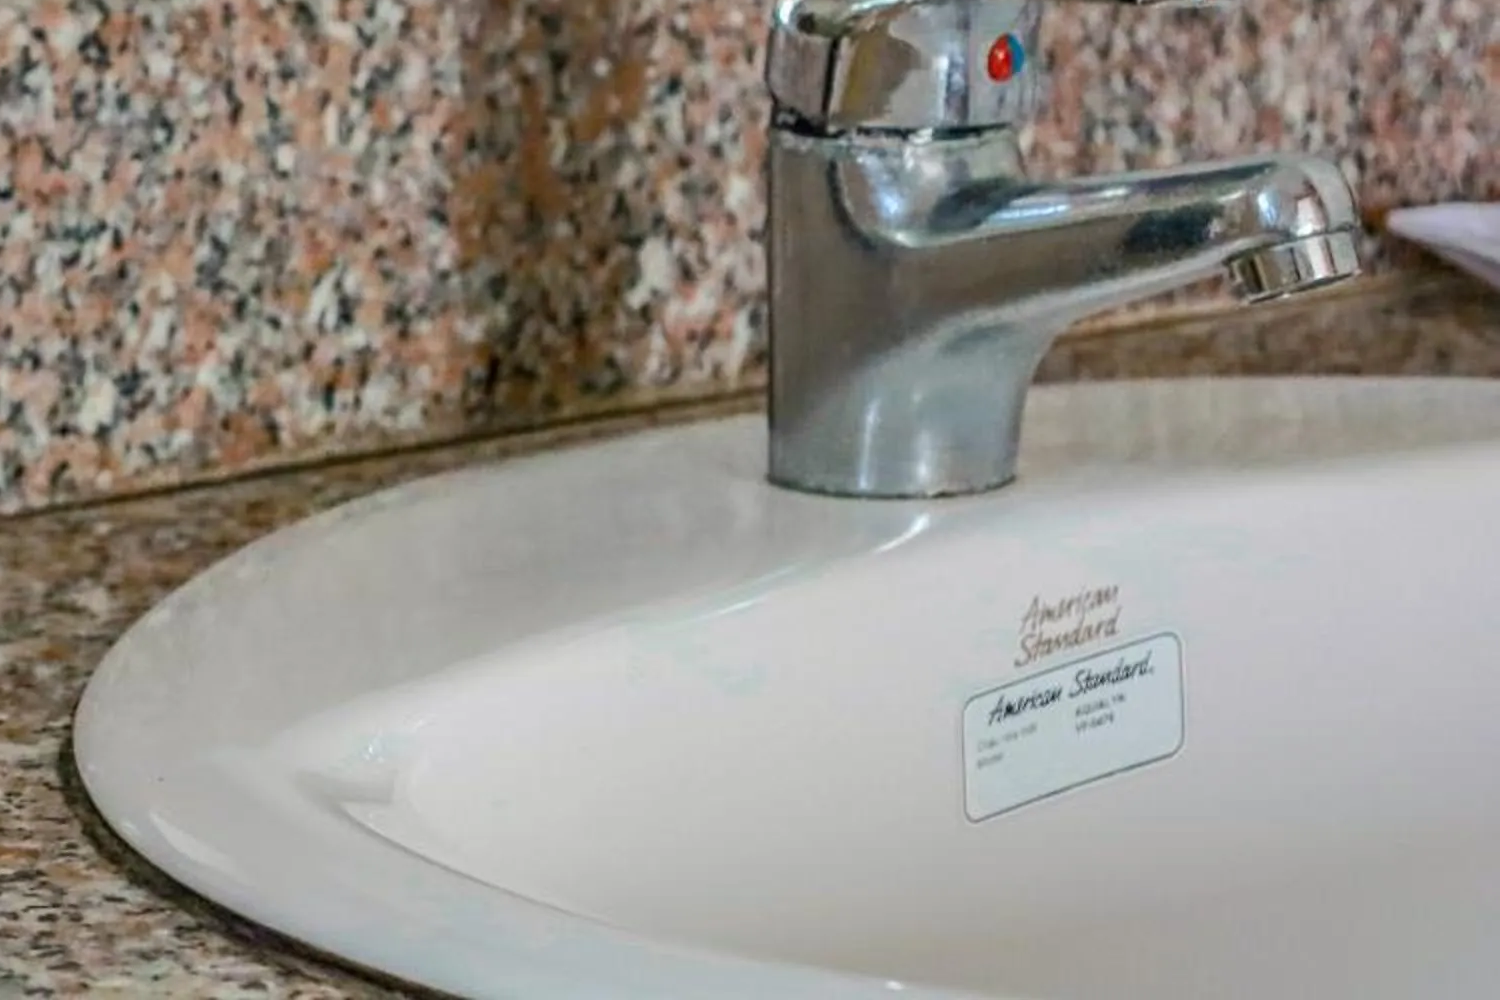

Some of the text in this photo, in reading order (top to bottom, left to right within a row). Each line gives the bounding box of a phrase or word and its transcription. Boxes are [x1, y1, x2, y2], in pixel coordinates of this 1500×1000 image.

[1019, 583, 1120, 634] American
[1013, 604, 1122, 668] Standard
[988, 692, 1063, 726] American
